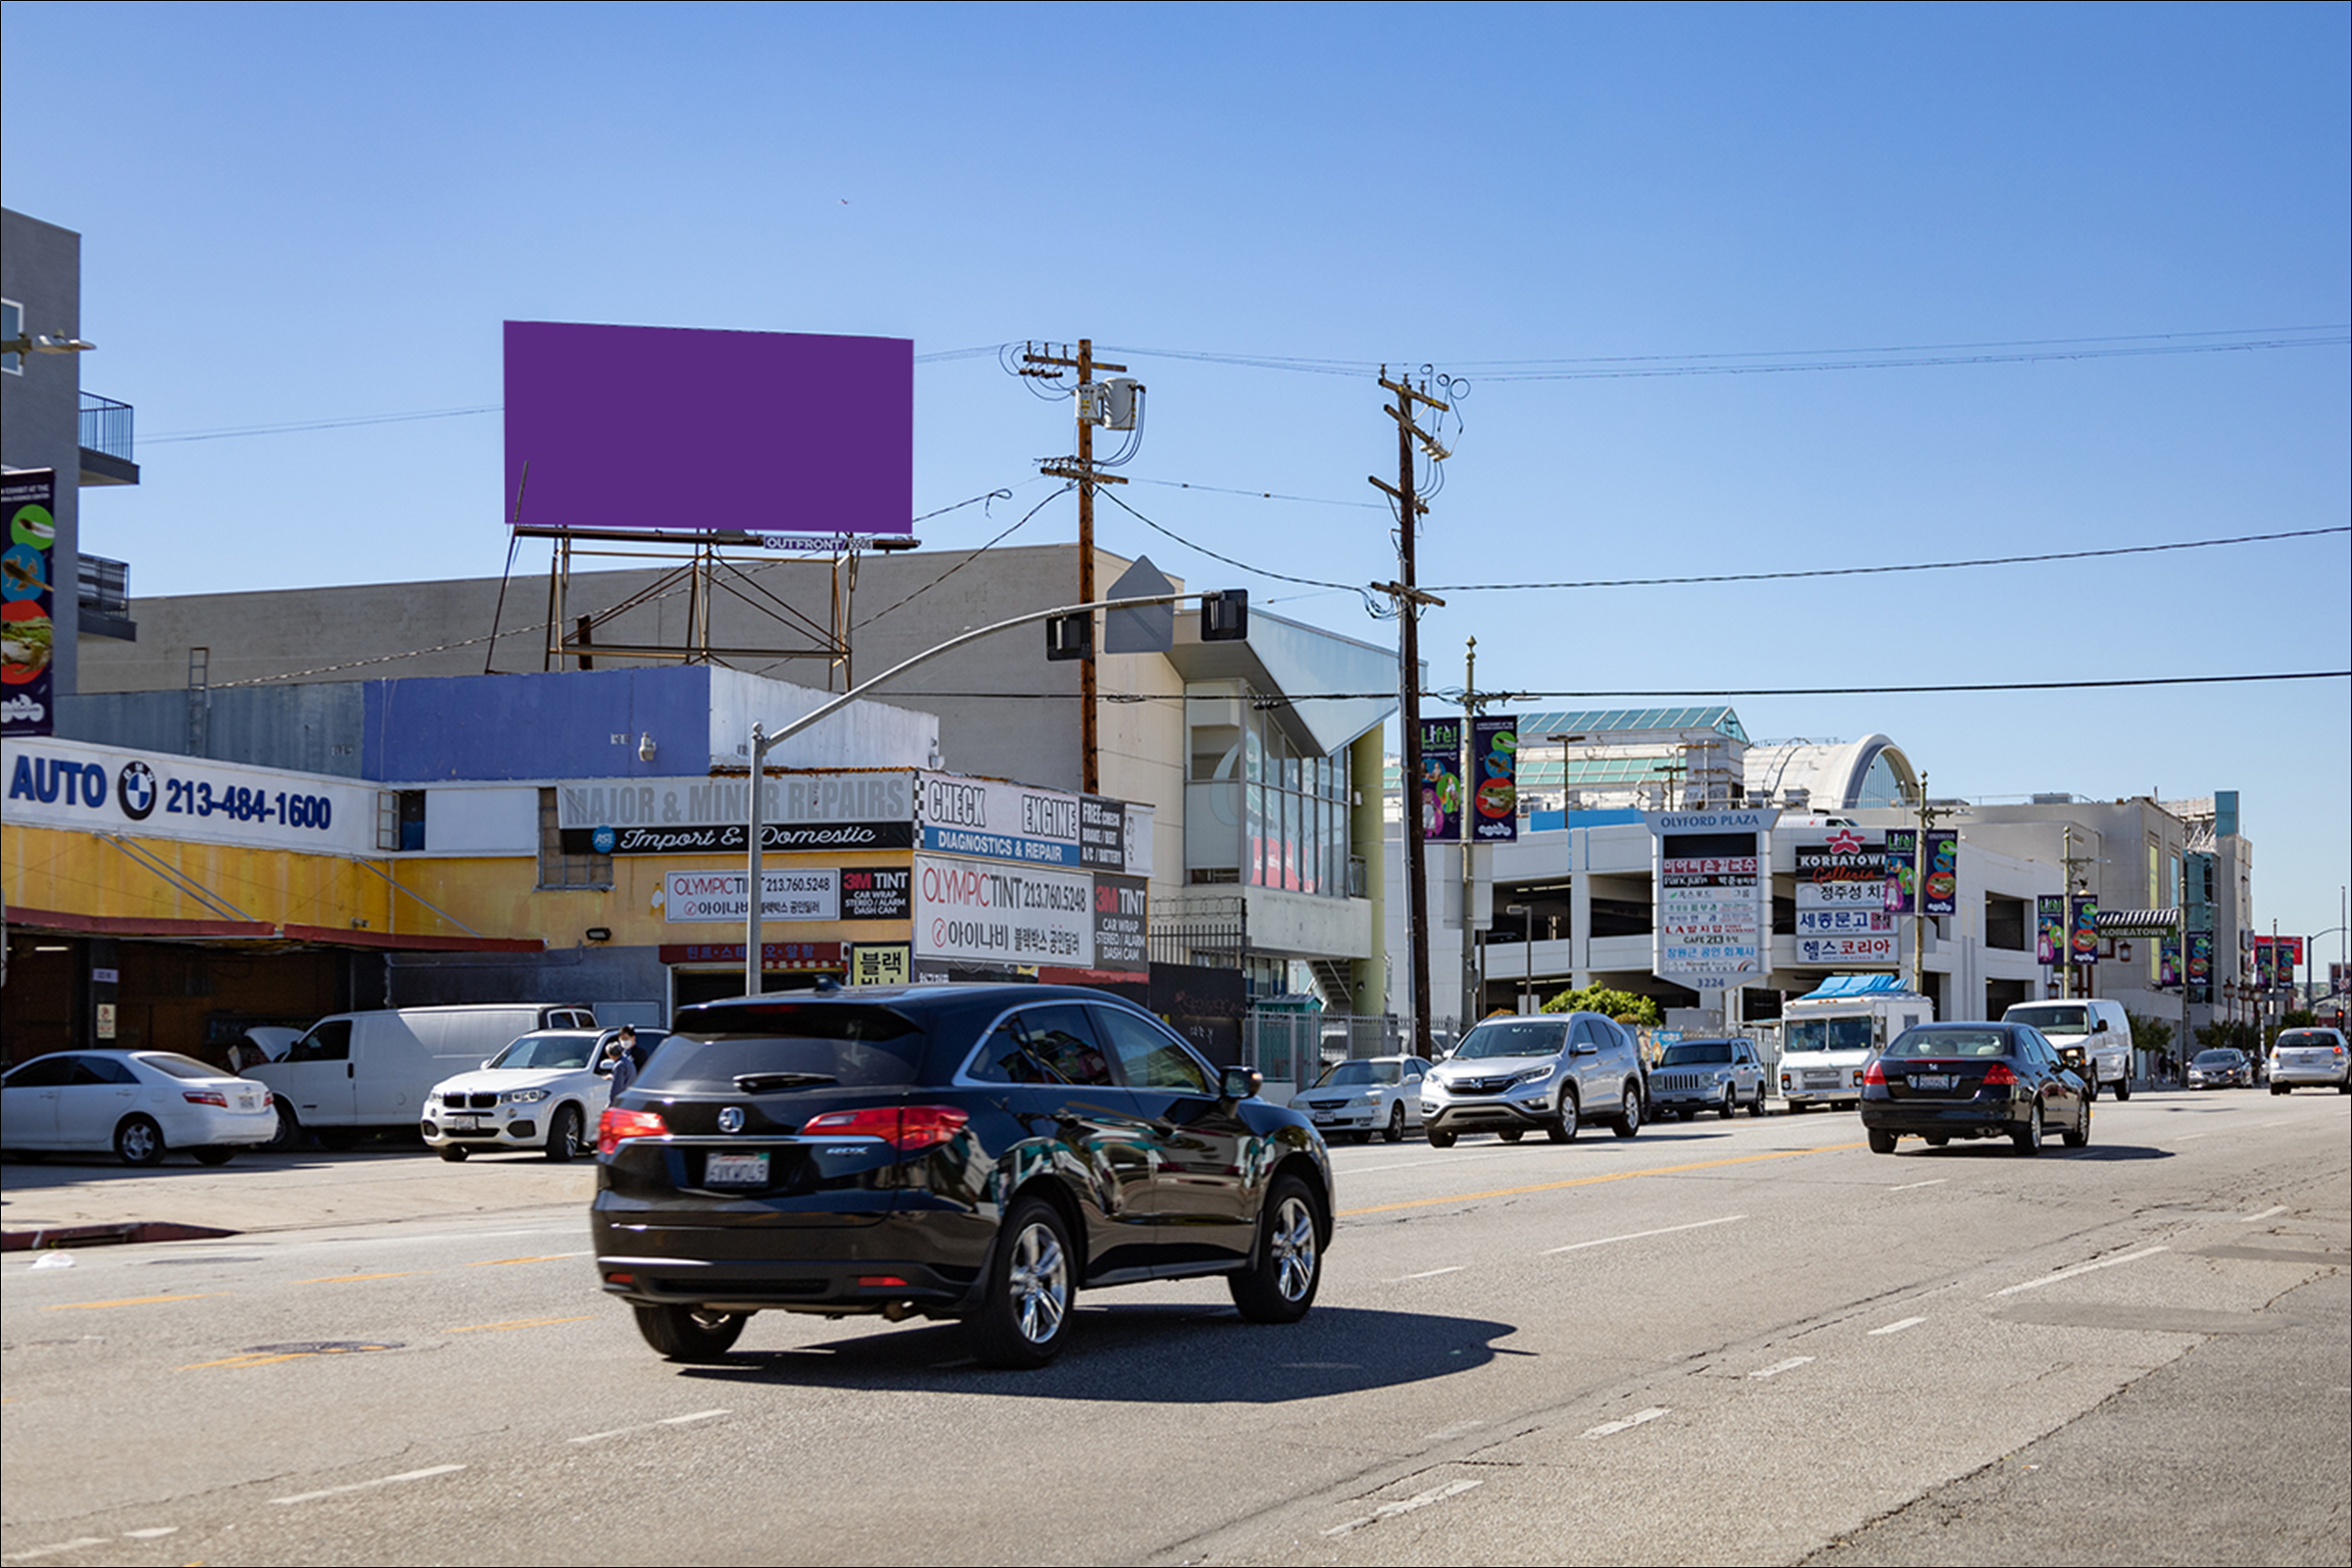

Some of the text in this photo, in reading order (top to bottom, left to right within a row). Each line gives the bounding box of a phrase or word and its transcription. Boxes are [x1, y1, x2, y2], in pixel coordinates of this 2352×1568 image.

[9, 756, 107, 808] AUTO
[166, 778, 331, 829] 213-484-1600
[566, 787, 655, 825] MAJOR
[662, 791, 682, 823] &
[788, 779, 904, 820] REPAIRS
[929, 779, 986, 828] CHECK
[1021, 794, 1077, 840] ENGINE
[1661, 815, 1759, 827] OLYFORD PLAZA
[620, 826, 876, 851] Import & Domestic
[938, 831, 1062, 861] DIAGNOSTICS & REPAIR
[765, 877, 831, 892] 213.760.5248
[843, 872, 908, 890] 3M TINT
[1820, 885, 1862, 901] 정주성
[872, 890, 898, 899] WRAP
[1024, 880, 1086, 912] 213.760.5248
[1095, 885, 1146, 916] 3M TINT
[1799, 911, 1868, 929] 세종문고
[948, 920, 1008, 952] 아이나비
[1706, 935, 1724, 945] 213
[860, 952, 902, 976] 블랙
[1696, 978, 1725, 988] 3224
